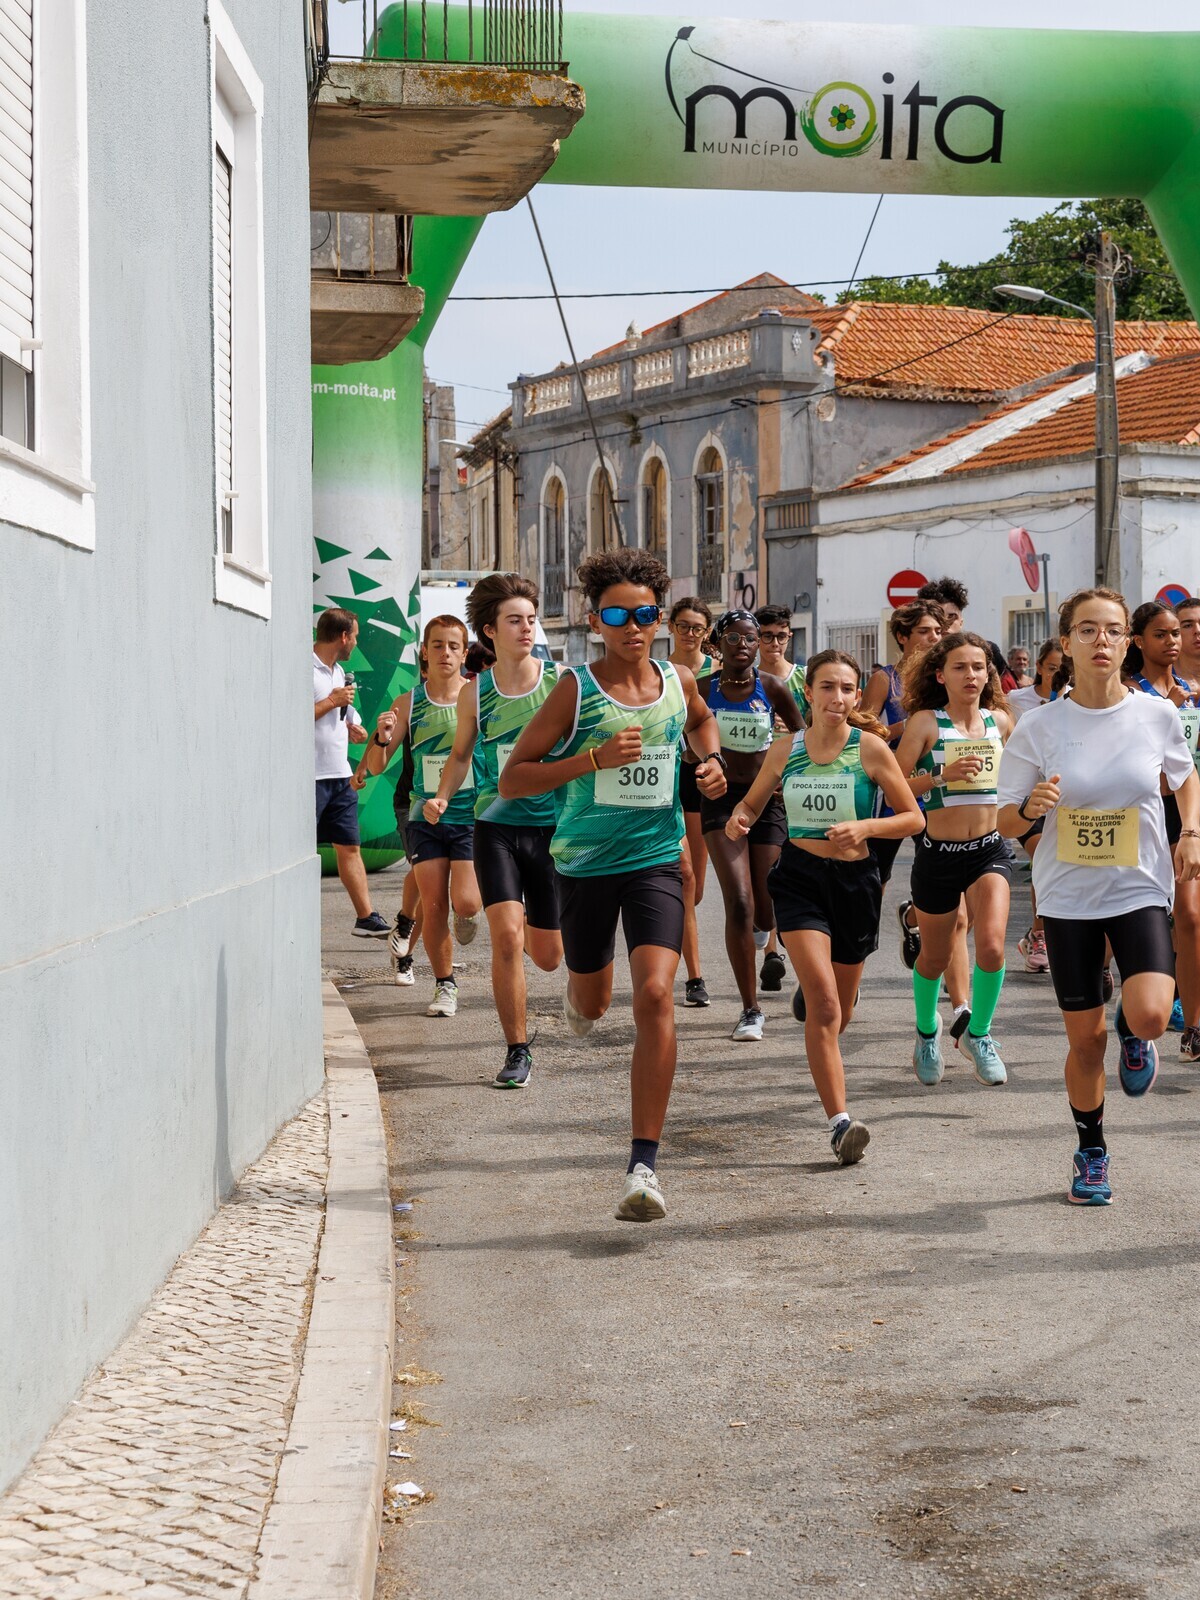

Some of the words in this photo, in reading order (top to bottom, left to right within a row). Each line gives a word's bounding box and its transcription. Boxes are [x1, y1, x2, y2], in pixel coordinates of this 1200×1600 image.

[683, 72, 1005, 164] moita
[702, 140, 799, 157] MUNICÍPIO
[311, 382, 397, 401] m-moita.pt
[729, 725, 758, 740] 414
[640, 753, 670, 761] 22/2023
[618, 767, 659, 786] 308
[802, 794, 837, 811] 400
[939, 840, 979, 852] NIKE
[1077, 828, 1115, 847] 531
